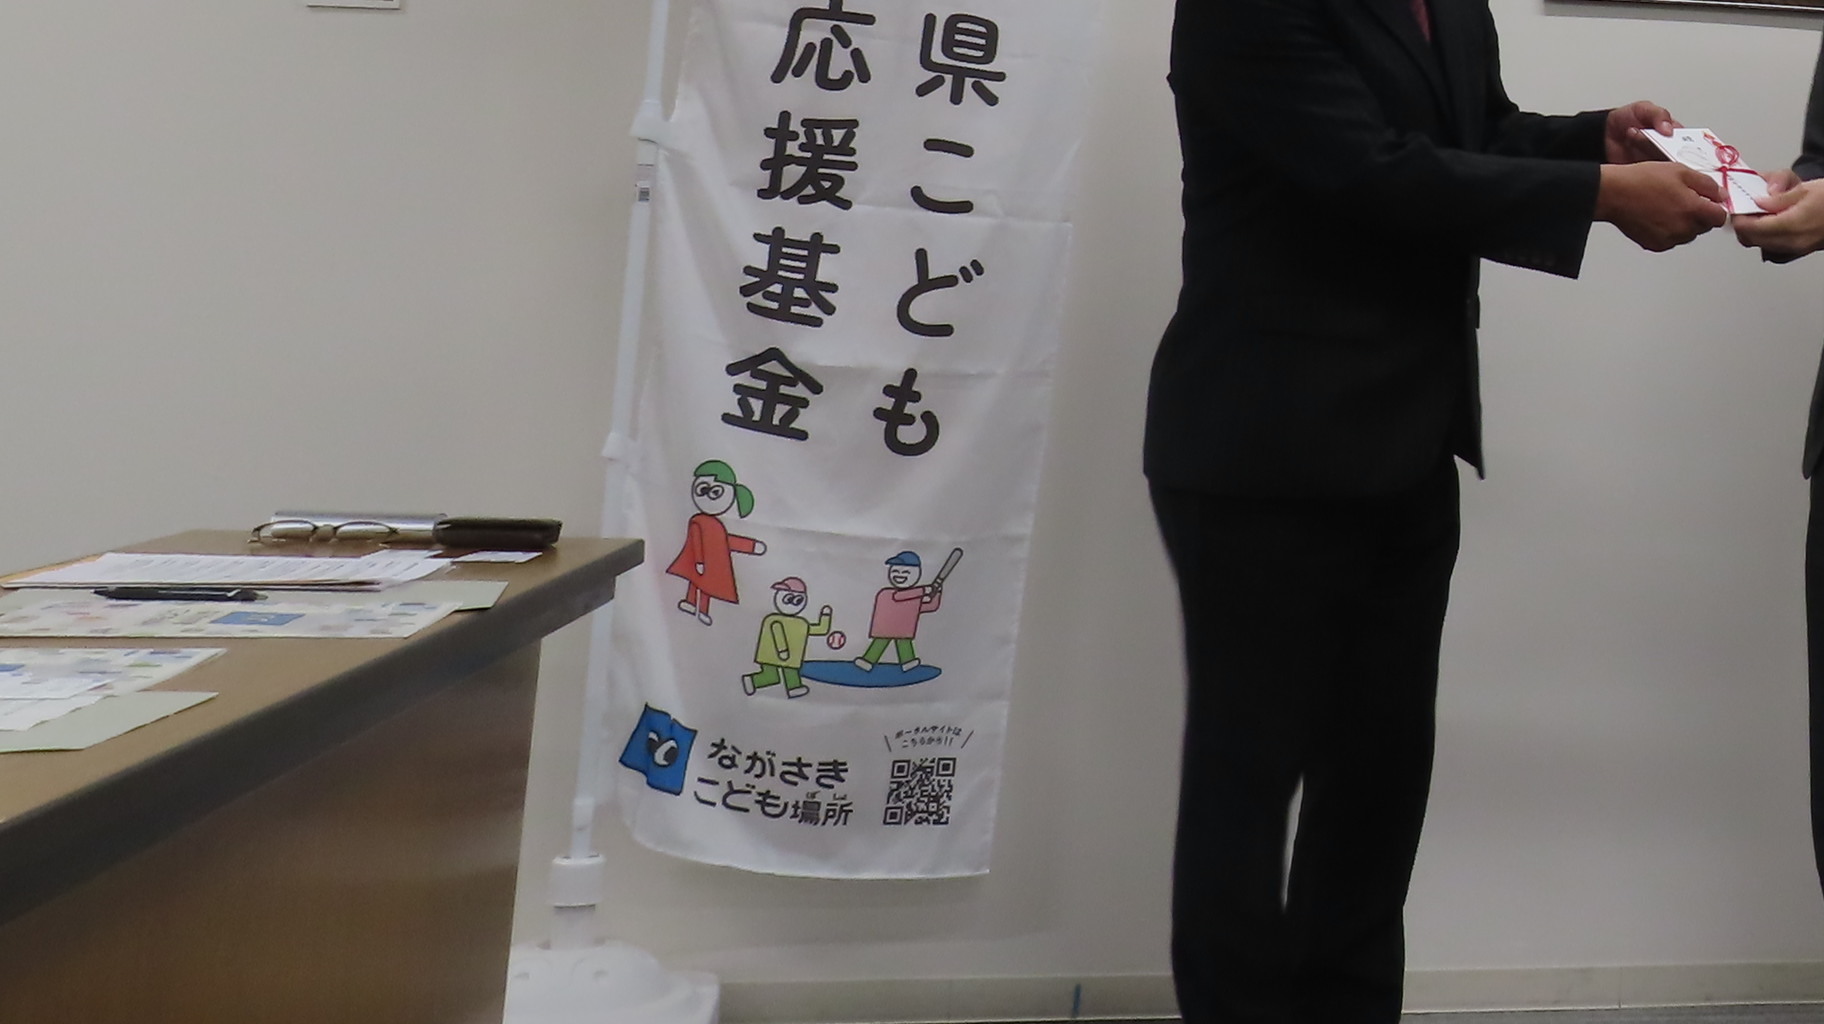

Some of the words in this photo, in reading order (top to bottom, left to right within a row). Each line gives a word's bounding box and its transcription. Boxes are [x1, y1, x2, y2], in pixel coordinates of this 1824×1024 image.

[707, 737, 849, 790] ながさき
[693, 776, 854, 827] こども場所
